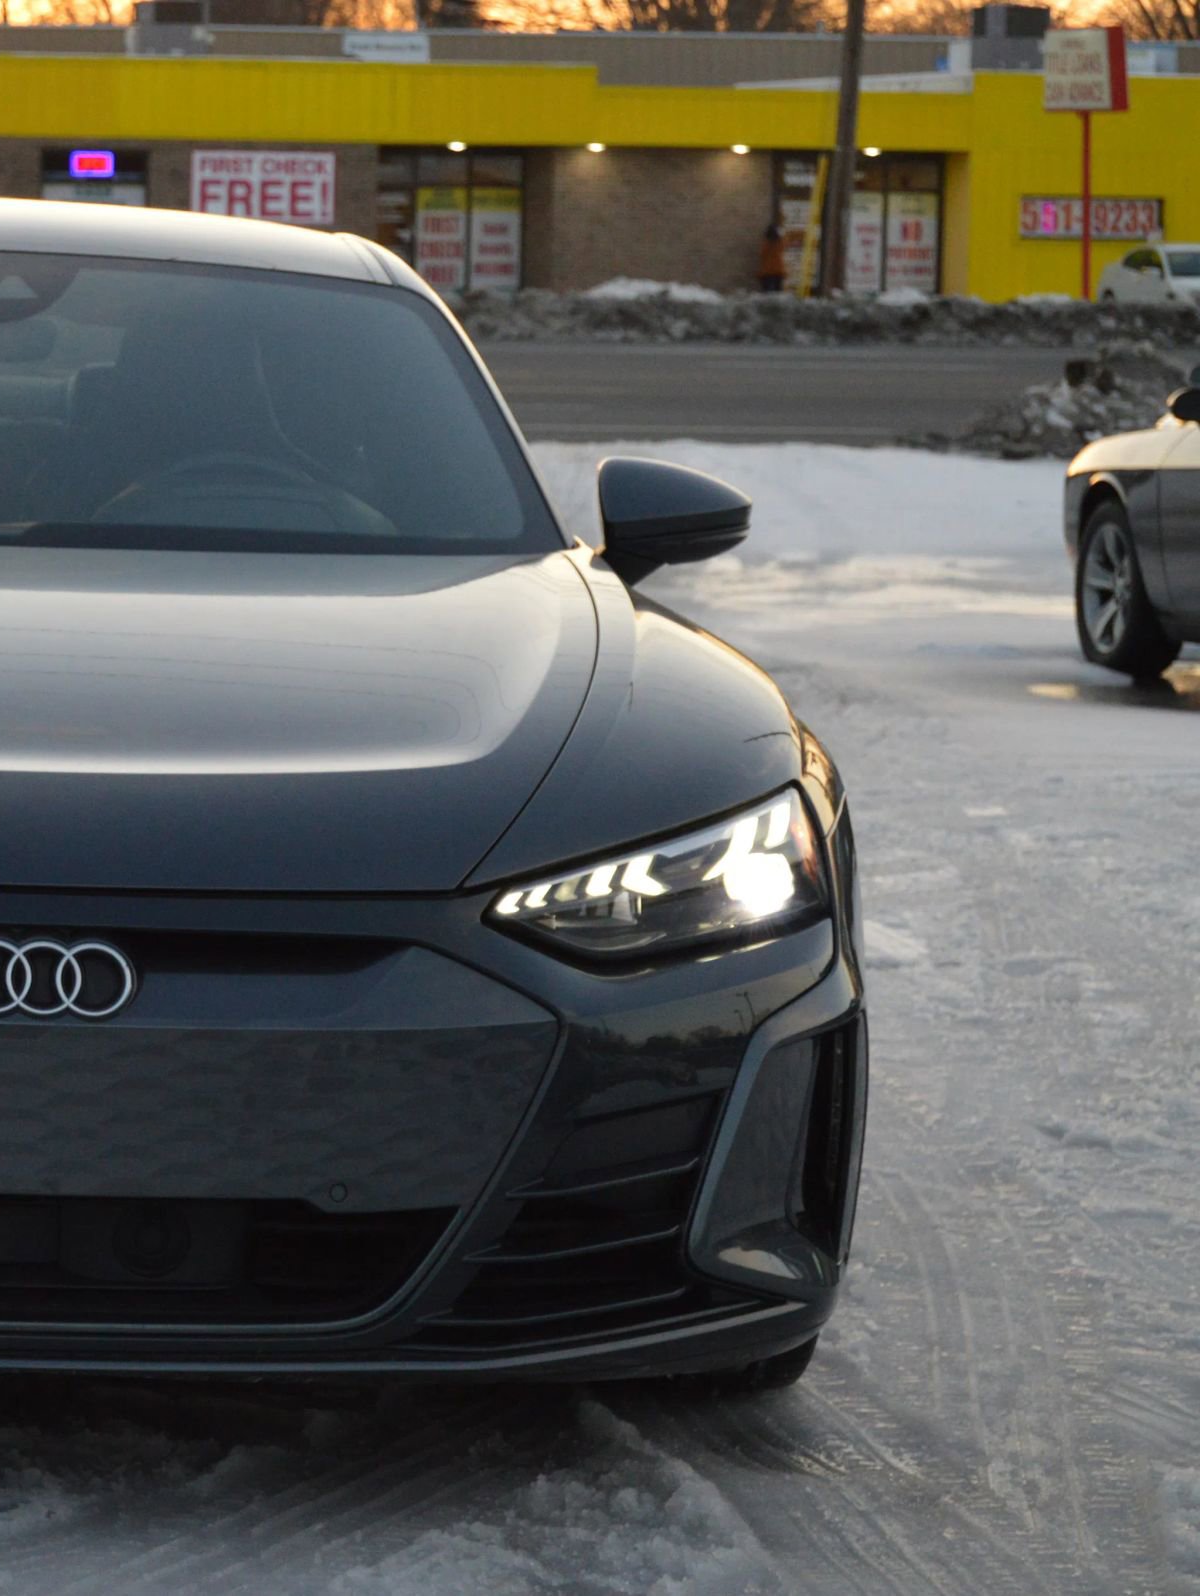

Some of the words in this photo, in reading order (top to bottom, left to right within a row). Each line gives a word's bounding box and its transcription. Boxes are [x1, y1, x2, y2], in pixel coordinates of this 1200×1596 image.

[200, 158, 253, 174] FIRST
[261, 159, 328, 175] CHECK
[199, 180, 329, 217] FREE!
